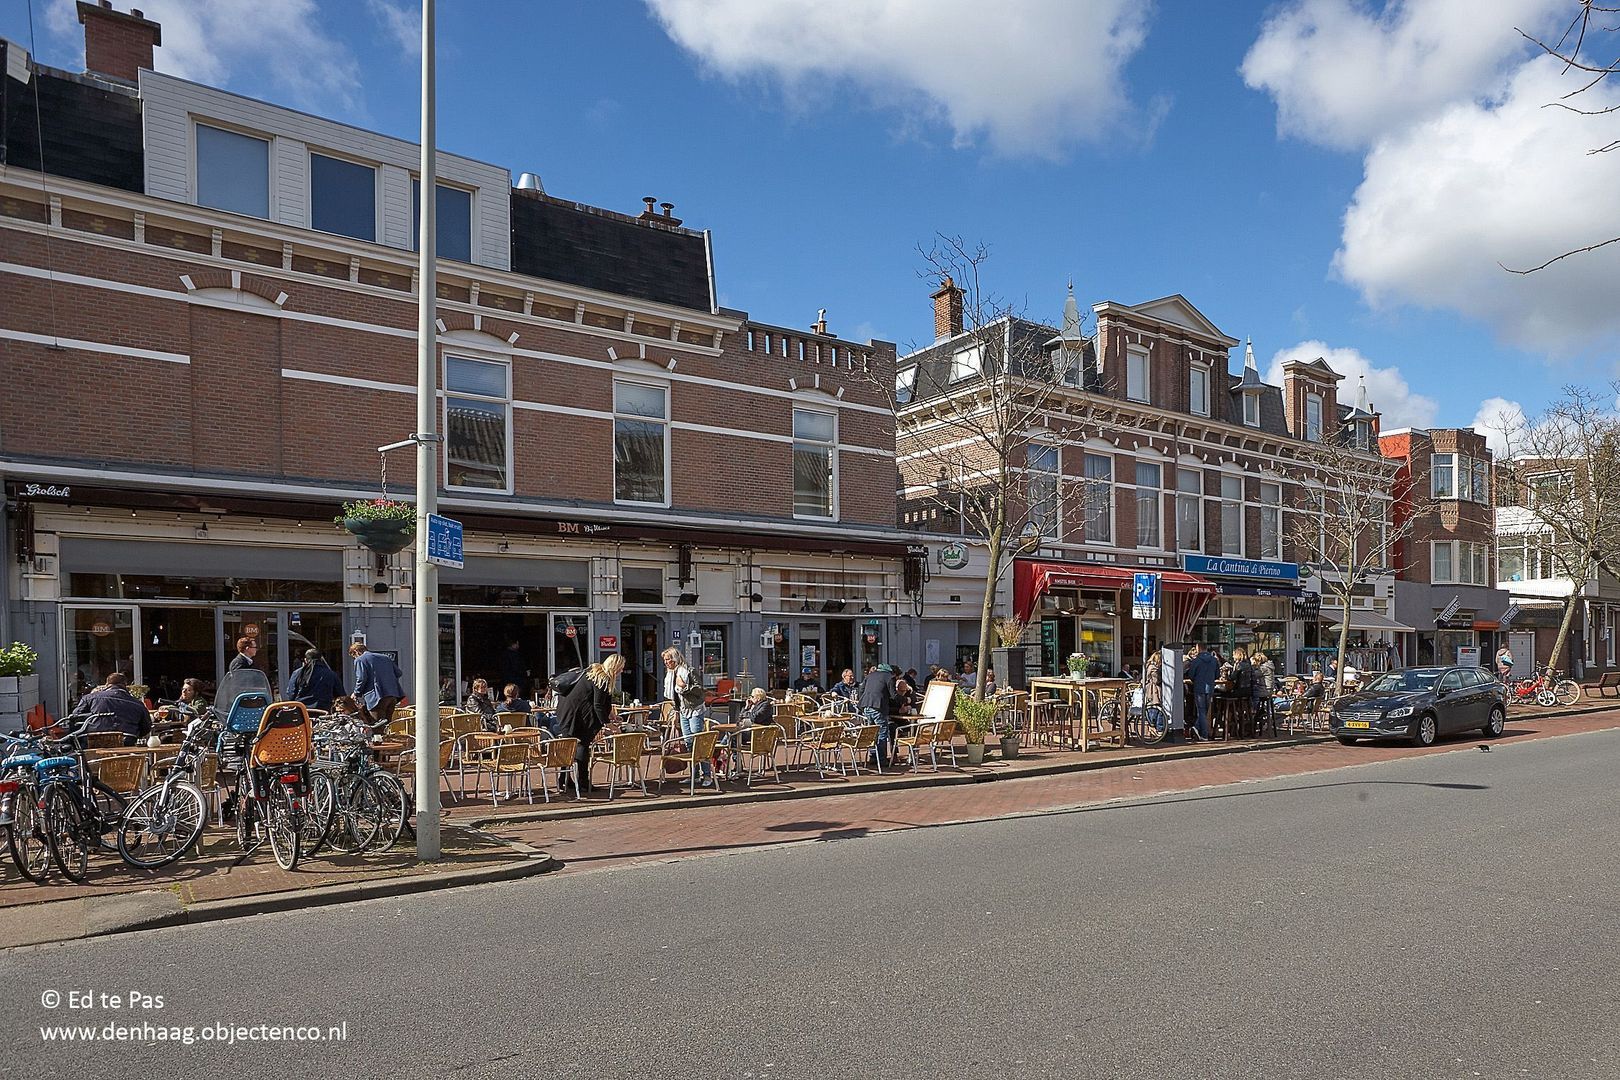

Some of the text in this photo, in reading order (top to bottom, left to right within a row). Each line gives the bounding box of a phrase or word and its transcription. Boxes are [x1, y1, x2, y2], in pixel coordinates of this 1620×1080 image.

[25, 483, 71, 497] Grolsch
[557, 521, 580, 533] BM
[1206, 558, 1281, 576] La Cantina di Pierino
